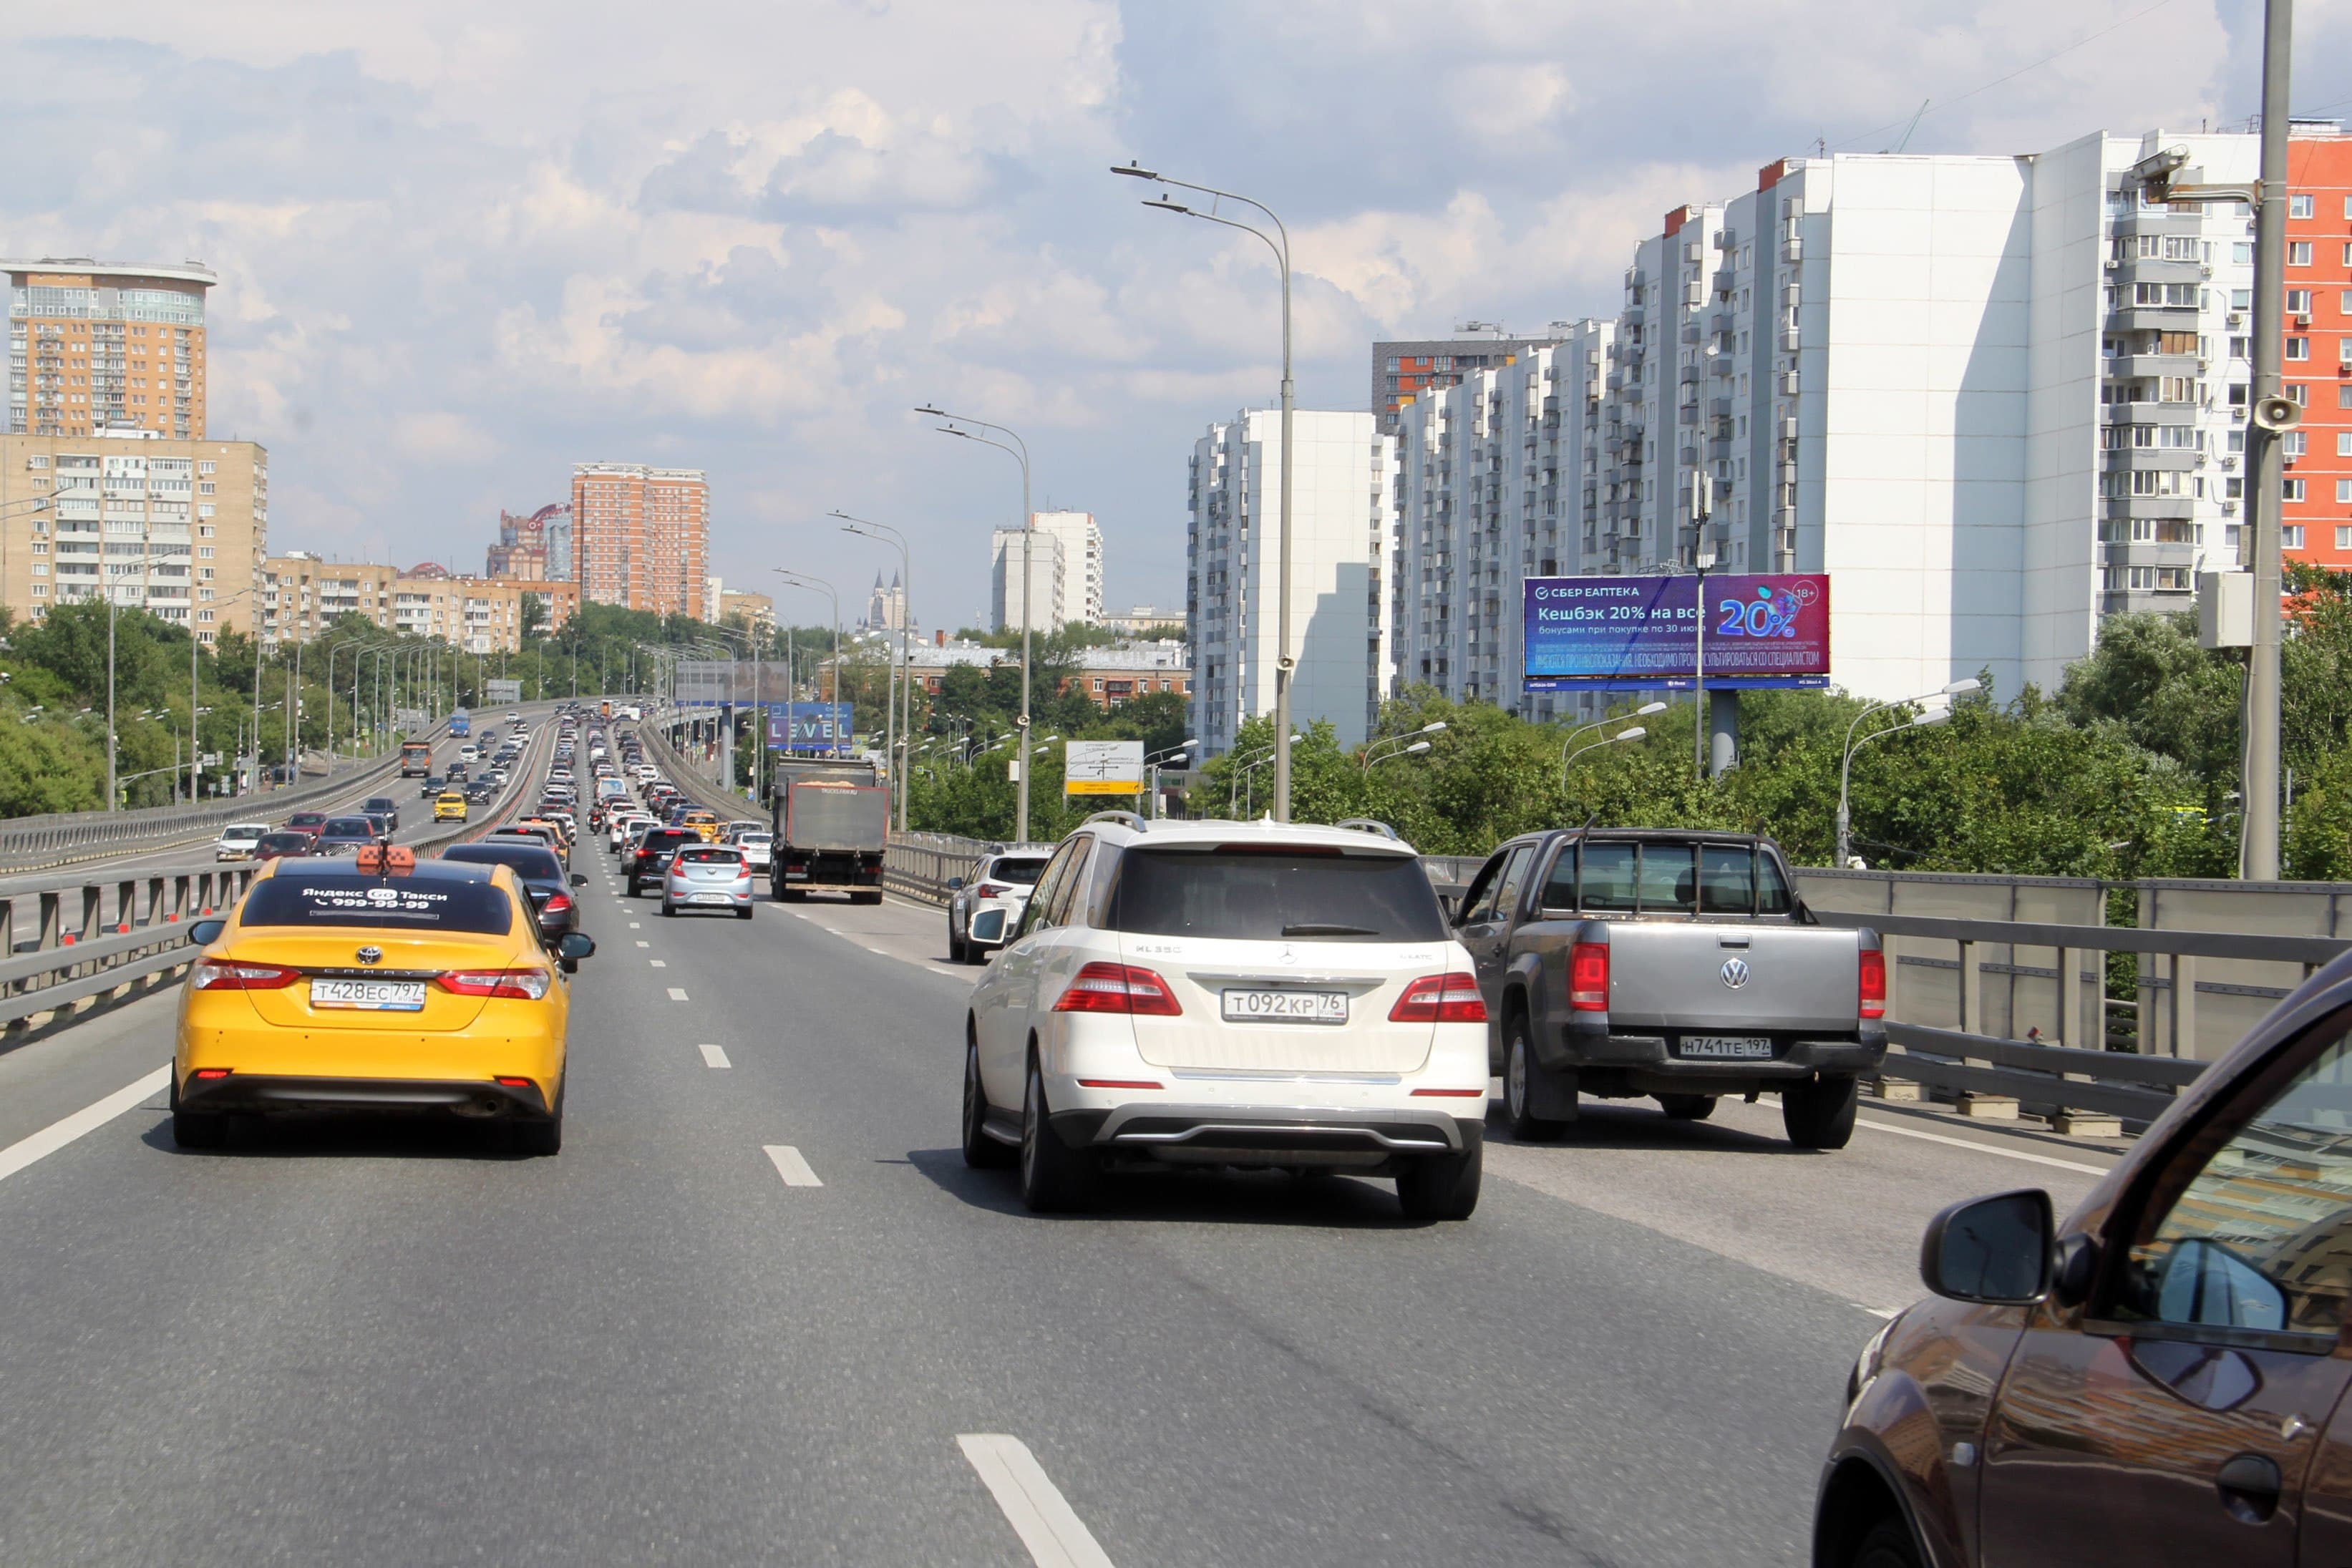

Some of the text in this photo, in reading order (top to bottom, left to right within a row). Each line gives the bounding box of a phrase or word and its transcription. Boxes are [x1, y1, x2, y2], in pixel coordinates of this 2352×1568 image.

[1551, 587, 1640, 598] СБЕР ЕАПТЕКА
[1796, 589, 1815, 598] 18+
[1538, 606, 1605, 620] Кешбэк
[1609, 606, 1646, 620] 20%
[1651, 608, 1671, 619] на
[1716, 599, 1796, 638] 20%
[1538, 625, 1585, 635] бонусами
[1588, 626, 1606, 635] при
[1608, 625, 1648, 635] покупке
[1666, 624, 1678, 633] 30
[1635, 652, 1677, 668] НЕОБХОДИМО
[1678, 651, 1758, 667] ПРОКСУЛЬТИРОВАТЬСЯ
[1759, 651, 1767, 666] СО
[1768, 651, 1819, 668] СПЕЦИАЛИСТОМ
[771, 723, 848, 738] LEVEL
[302, 888, 364, 897] Яндекс
[400, 891, 448, 901] Такси
[331, 898, 429, 910] 999-99-99
[394, 983, 421, 997] 797
[1320, 995, 1340, 1009] 76
[1746, 1039, 1767, 1051] 197
